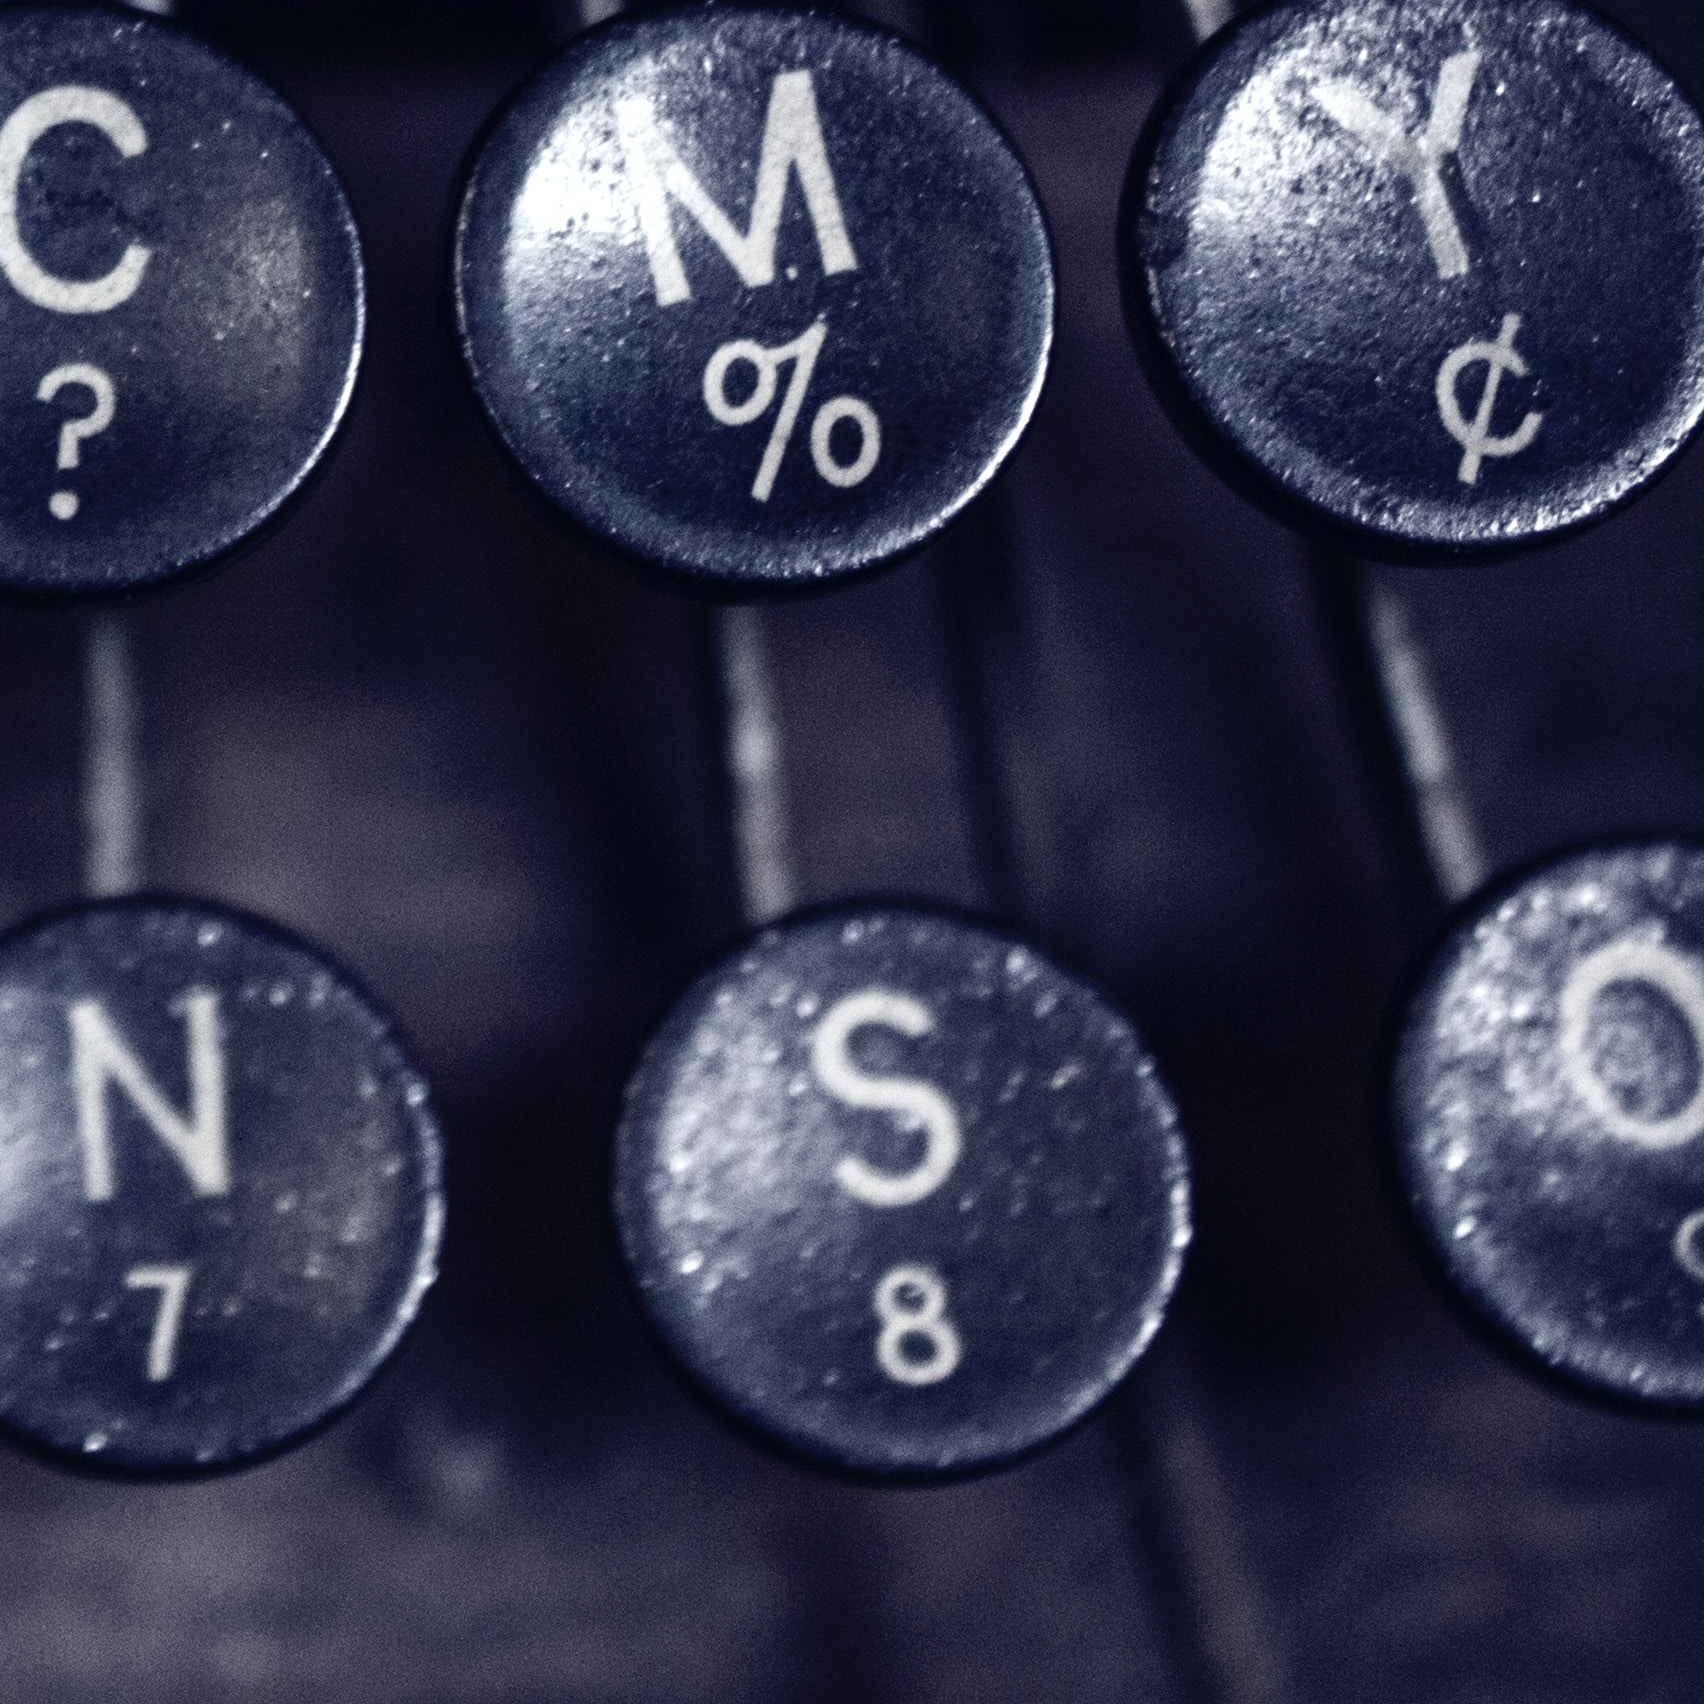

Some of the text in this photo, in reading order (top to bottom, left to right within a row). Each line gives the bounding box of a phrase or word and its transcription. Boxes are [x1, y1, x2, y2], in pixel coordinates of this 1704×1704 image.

[614, 68, 858, 305] M
[1309, 48, 1482, 279] Y
[34, 360, 116, 522] ?
[702, 319, 881, 502] %
[1434, 311, 1544, 484] ¢
[67, 985, 229, 1202] N
[810, 988, 961, 1207] S
[122, 1263, 192, 1381] 7
[873, 1262, 962, 1385] 8
